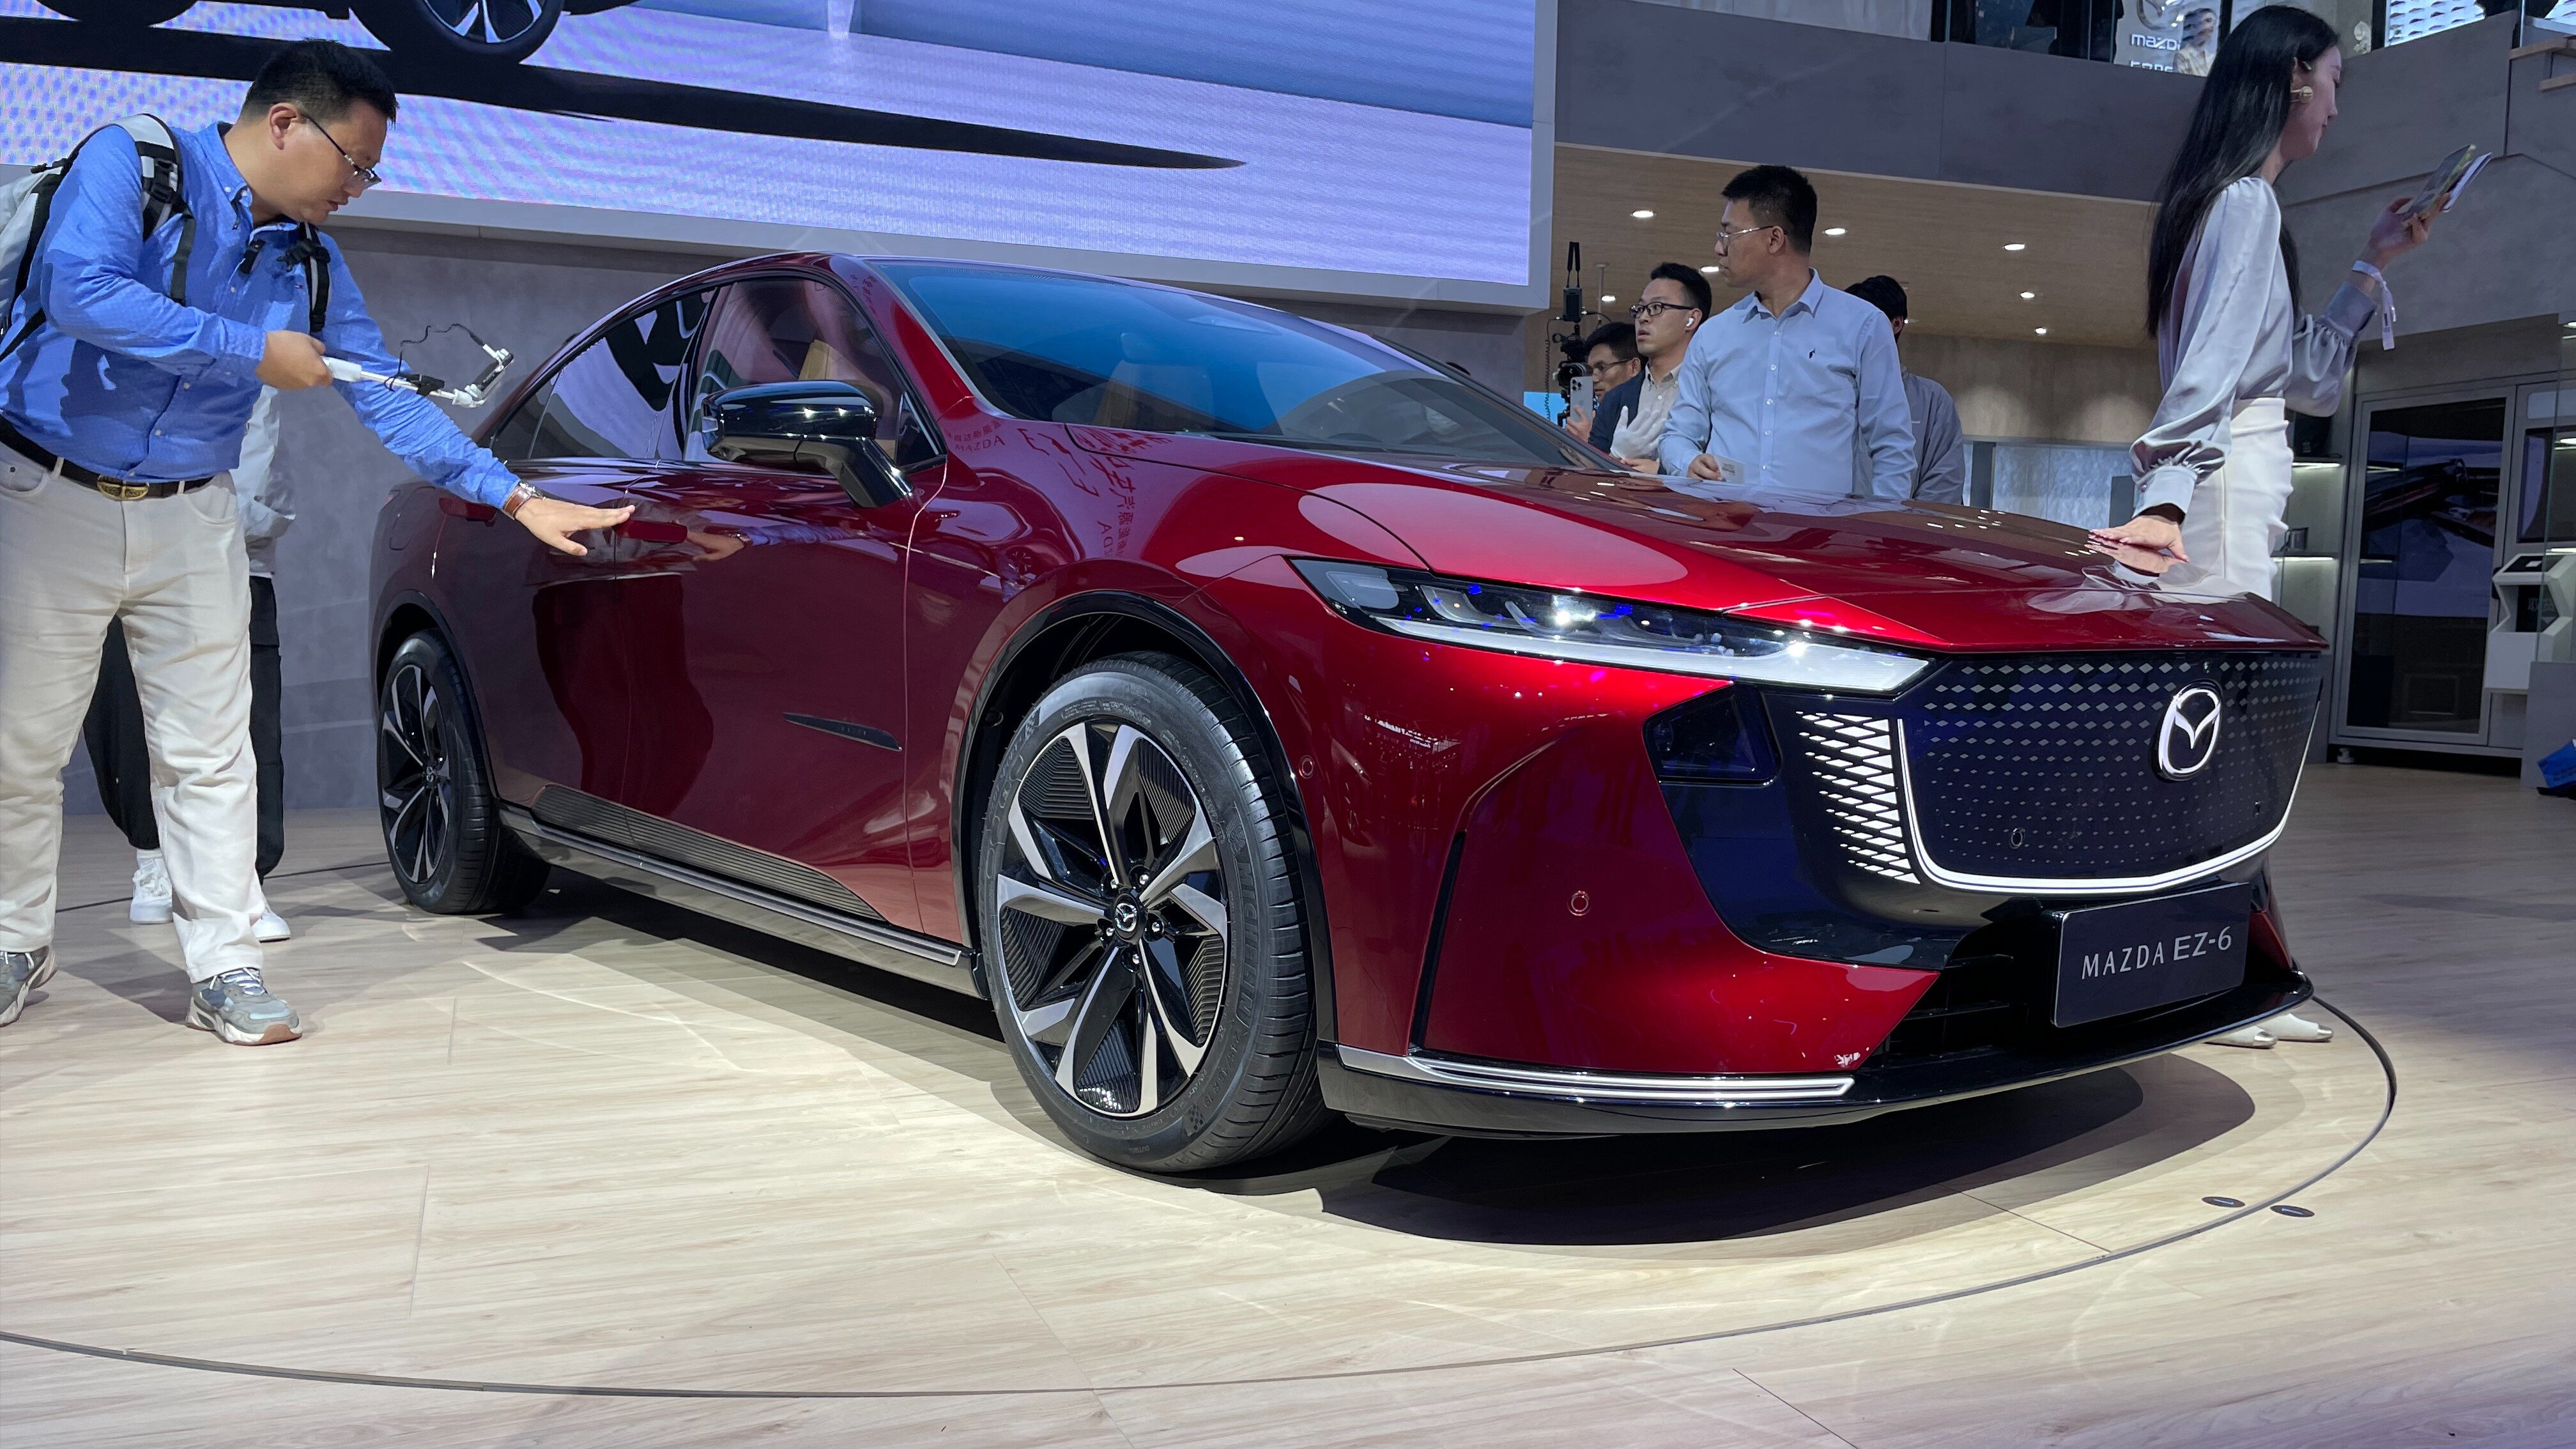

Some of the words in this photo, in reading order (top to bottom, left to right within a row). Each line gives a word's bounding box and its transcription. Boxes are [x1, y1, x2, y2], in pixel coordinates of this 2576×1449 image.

[1237, 857, 1257, 1017] MICHELIN
[2082, 942, 2164, 979] MAZDA
[2174, 926, 2232, 961] EZ-6
